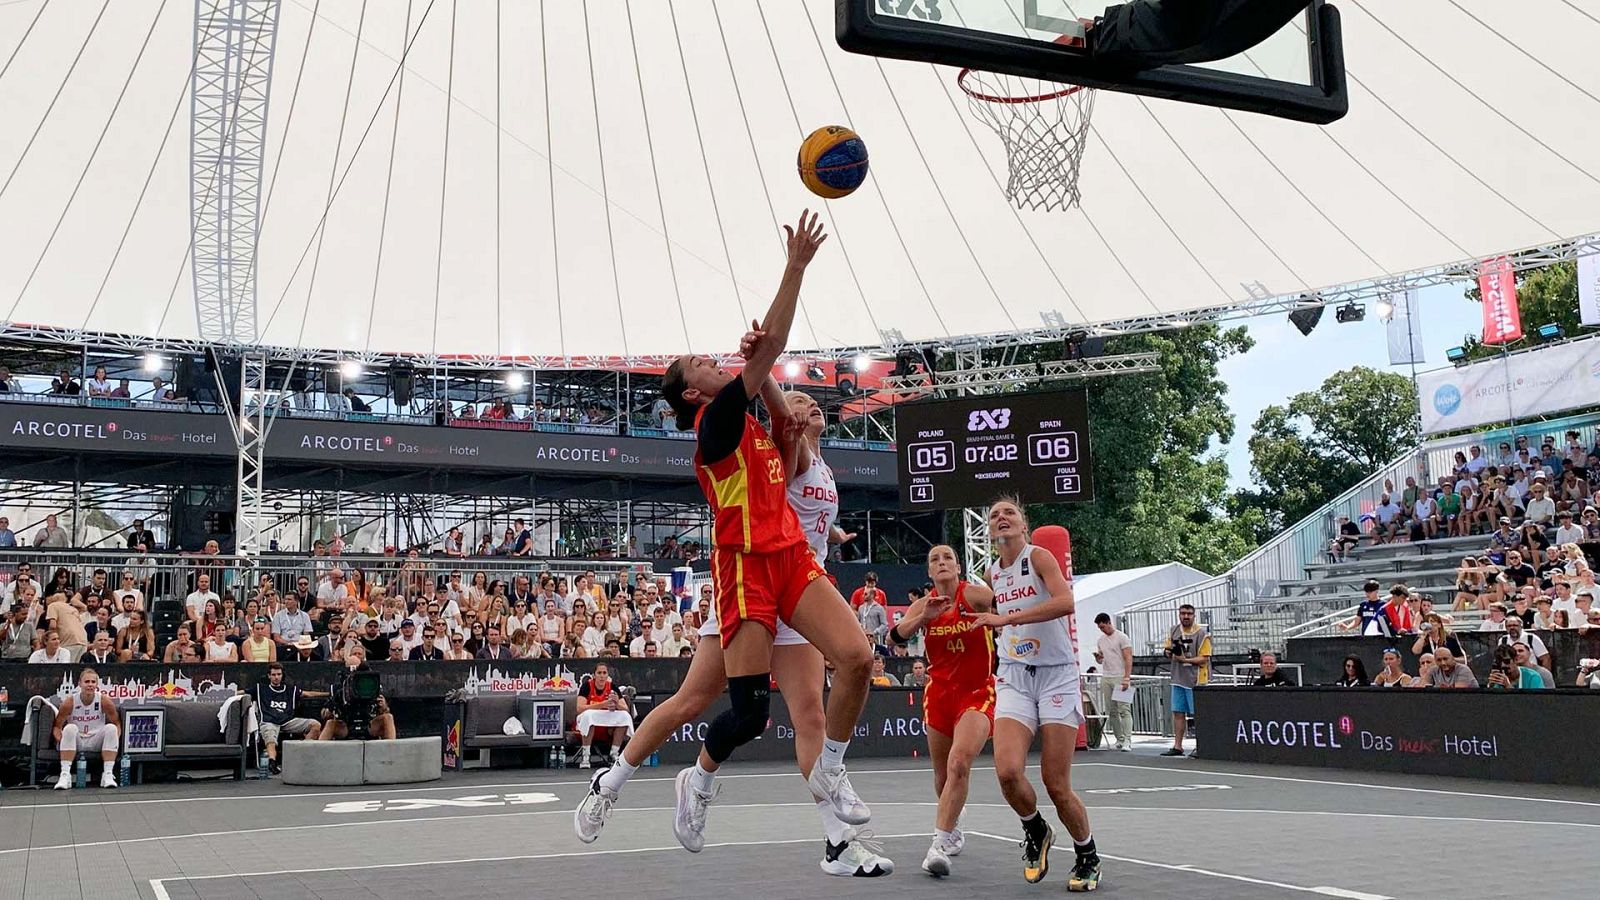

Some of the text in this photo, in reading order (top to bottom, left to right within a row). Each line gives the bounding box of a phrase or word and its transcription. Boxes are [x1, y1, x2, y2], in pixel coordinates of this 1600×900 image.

[1039, 420, 1062, 429] SPAIN
[12, 420, 107, 438] ARCOTEL
[123, 429, 147, 441] Das
[182, 432, 216, 444] Hotel
[918, 429, 944, 438] POLAND
[300, 434, 384, 452] ARCOTEL
[398, 442, 419, 454] Das
[449, 445, 479, 456] Hotel
[1036, 437, 1070, 460] 06
[536, 446, 609, 462] ARCOTEL
[621, 453, 640, 464] Das
[666, 456, 693, 466] Hotel
[916, 446, 947, 469] 05
[965, 444, 1018, 464] 07:02
[767, 457, 784, 485] 22
[854, 466, 879, 476] Hotel
[912, 476, 930, 484] FOULS
[1063, 478, 1073, 490] 2
[917, 487, 926, 499] 4
[947, 638, 965, 653] 44
[120, 685, 144, 698] Bull
[493, 679, 537, 691] Red Bull
[777, 725, 794, 739] Da
[1235, 719, 1341, 749] ARCOTEL
[1361, 731, 1393, 751] Das
[1444, 735, 1498, 757] Hotel
